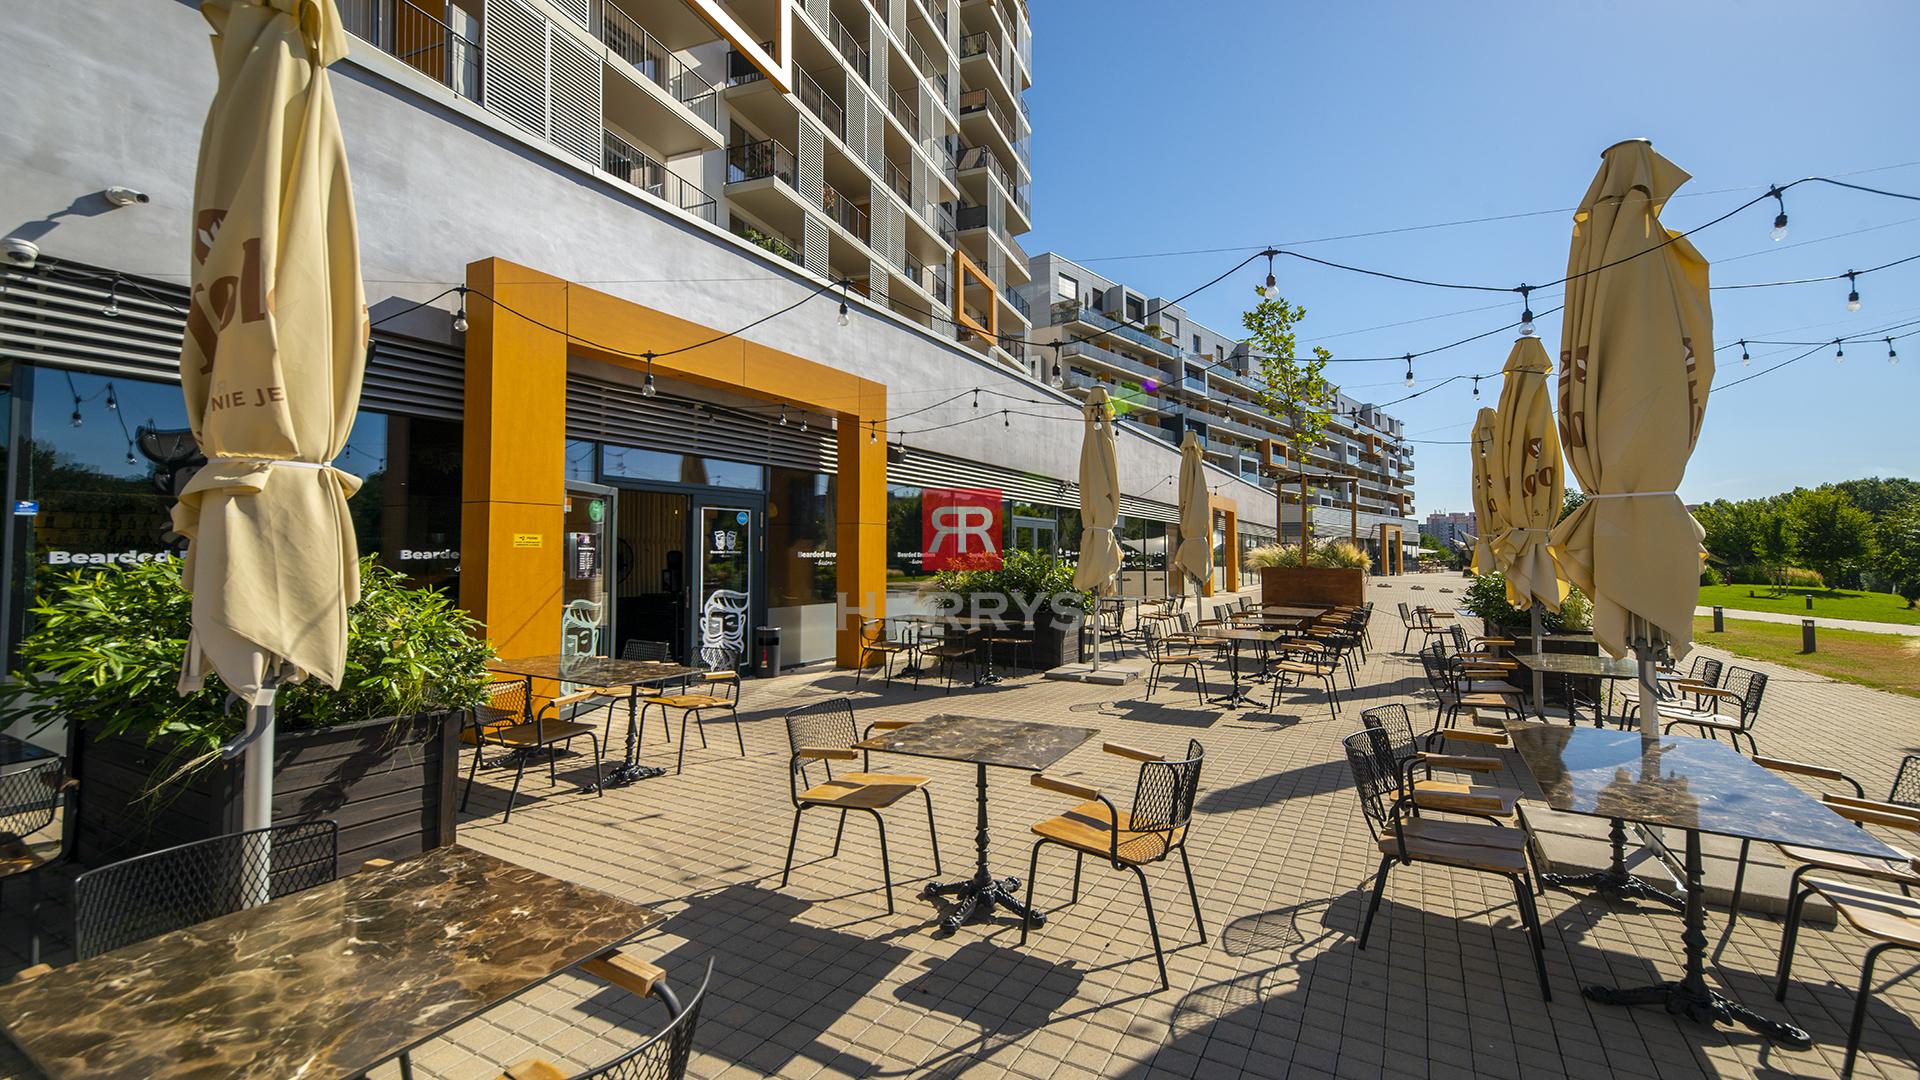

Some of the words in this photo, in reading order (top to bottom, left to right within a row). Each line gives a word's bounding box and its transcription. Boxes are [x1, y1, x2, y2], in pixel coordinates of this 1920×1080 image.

[211, 391, 246, 412] NIE
[254, 387, 285, 407] JE
[49, 550, 172, 564] Bearded
